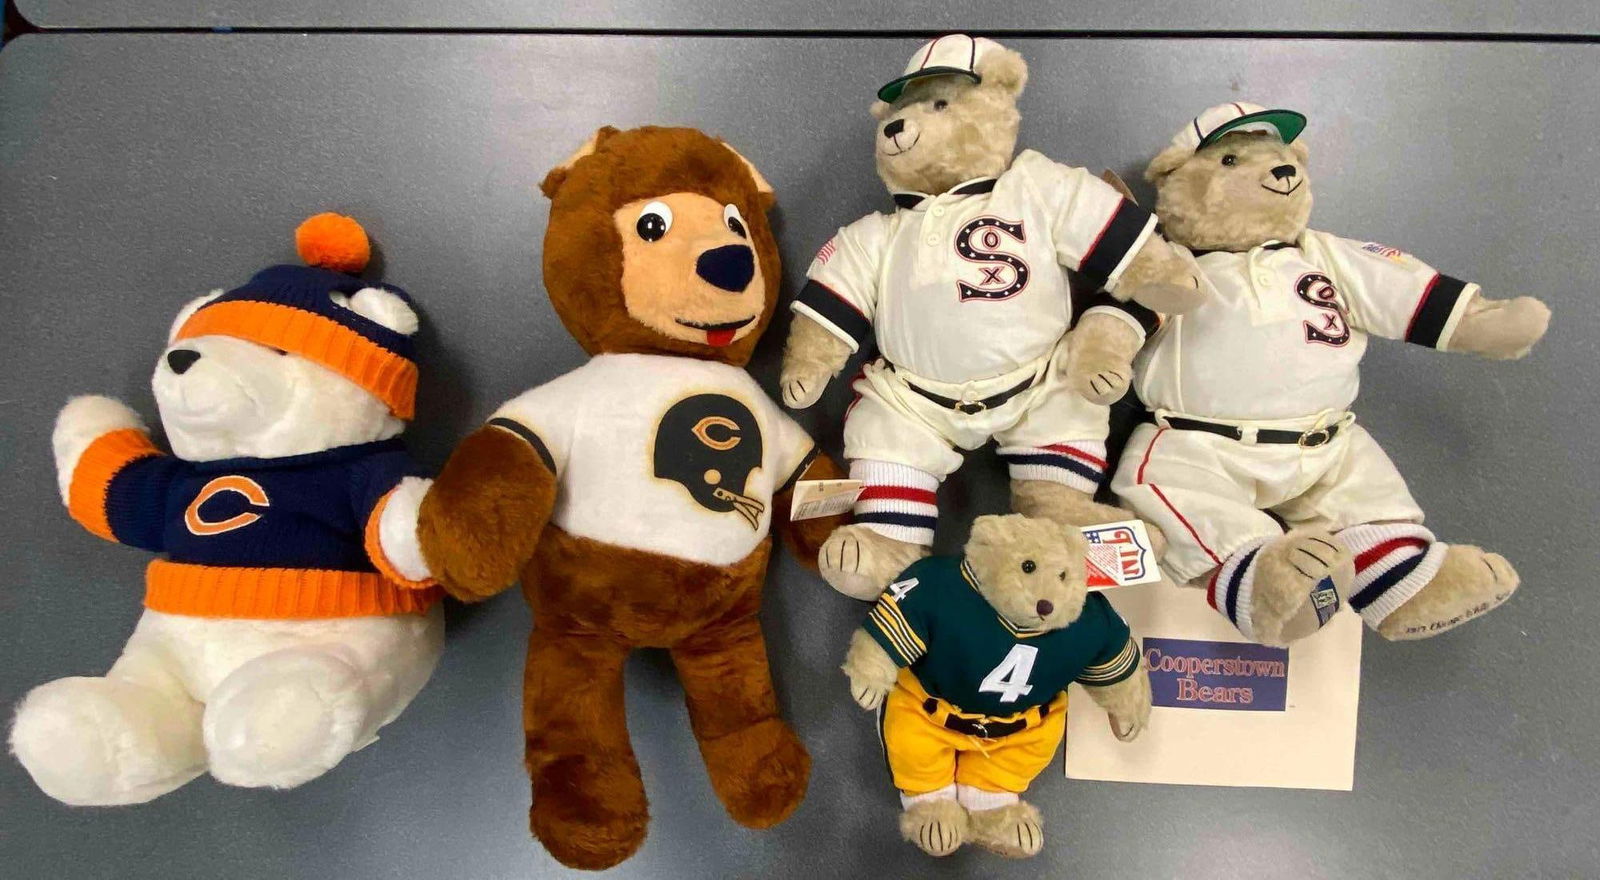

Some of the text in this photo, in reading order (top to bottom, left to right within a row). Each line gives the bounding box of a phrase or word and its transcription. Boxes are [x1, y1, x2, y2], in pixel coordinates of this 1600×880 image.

[691, 416, 741, 450] C
[185, 475, 269, 536] C
[890, 577, 919, 602] 4
[978, 643, 1039, 703] 4
[1144, 648, 1286, 679] Cooperstown
[1176, 677, 1254, 704] Bears
